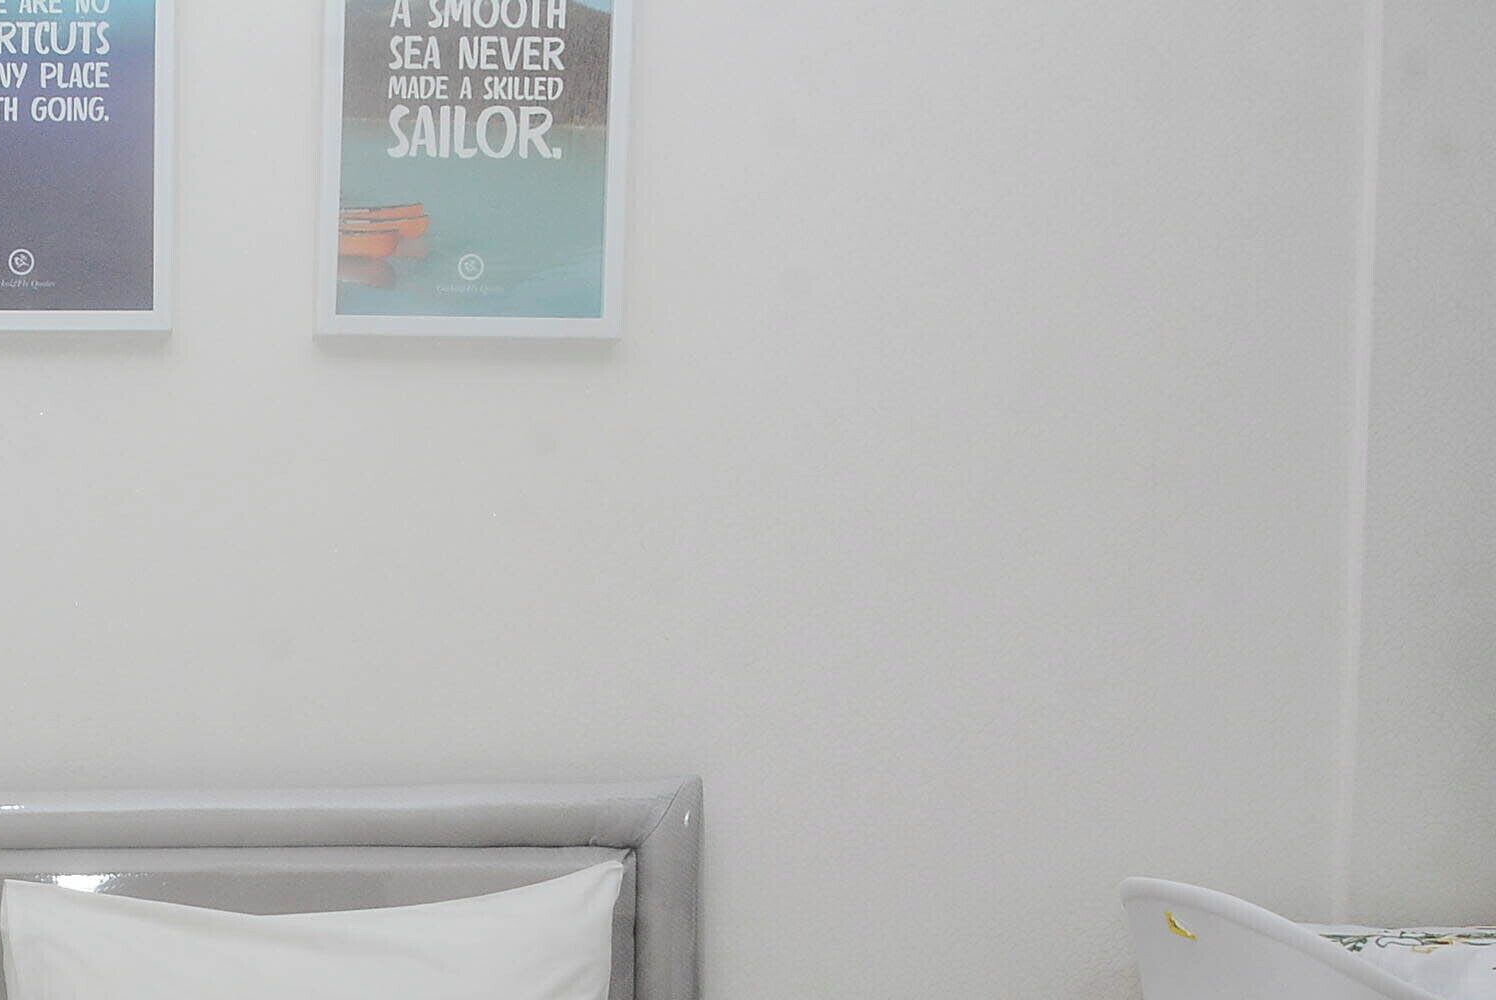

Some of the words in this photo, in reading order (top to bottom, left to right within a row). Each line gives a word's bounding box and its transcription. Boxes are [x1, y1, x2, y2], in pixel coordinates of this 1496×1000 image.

[390, 0, 412, 28] A
[428, 0, 567, 30] SMOOTH
[388, 35, 441, 70] SEA
[458, 35, 566, 71] NEVER
[40, 62, 110, 89] PLACE
[388, 75, 449, 100] MADE
[459, 76, 473, 100] A
[483, 76, 565, 101] SKILLED
[31, 96, 110, 122] GOING.
[387, 104, 563, 160] SAILOR.
